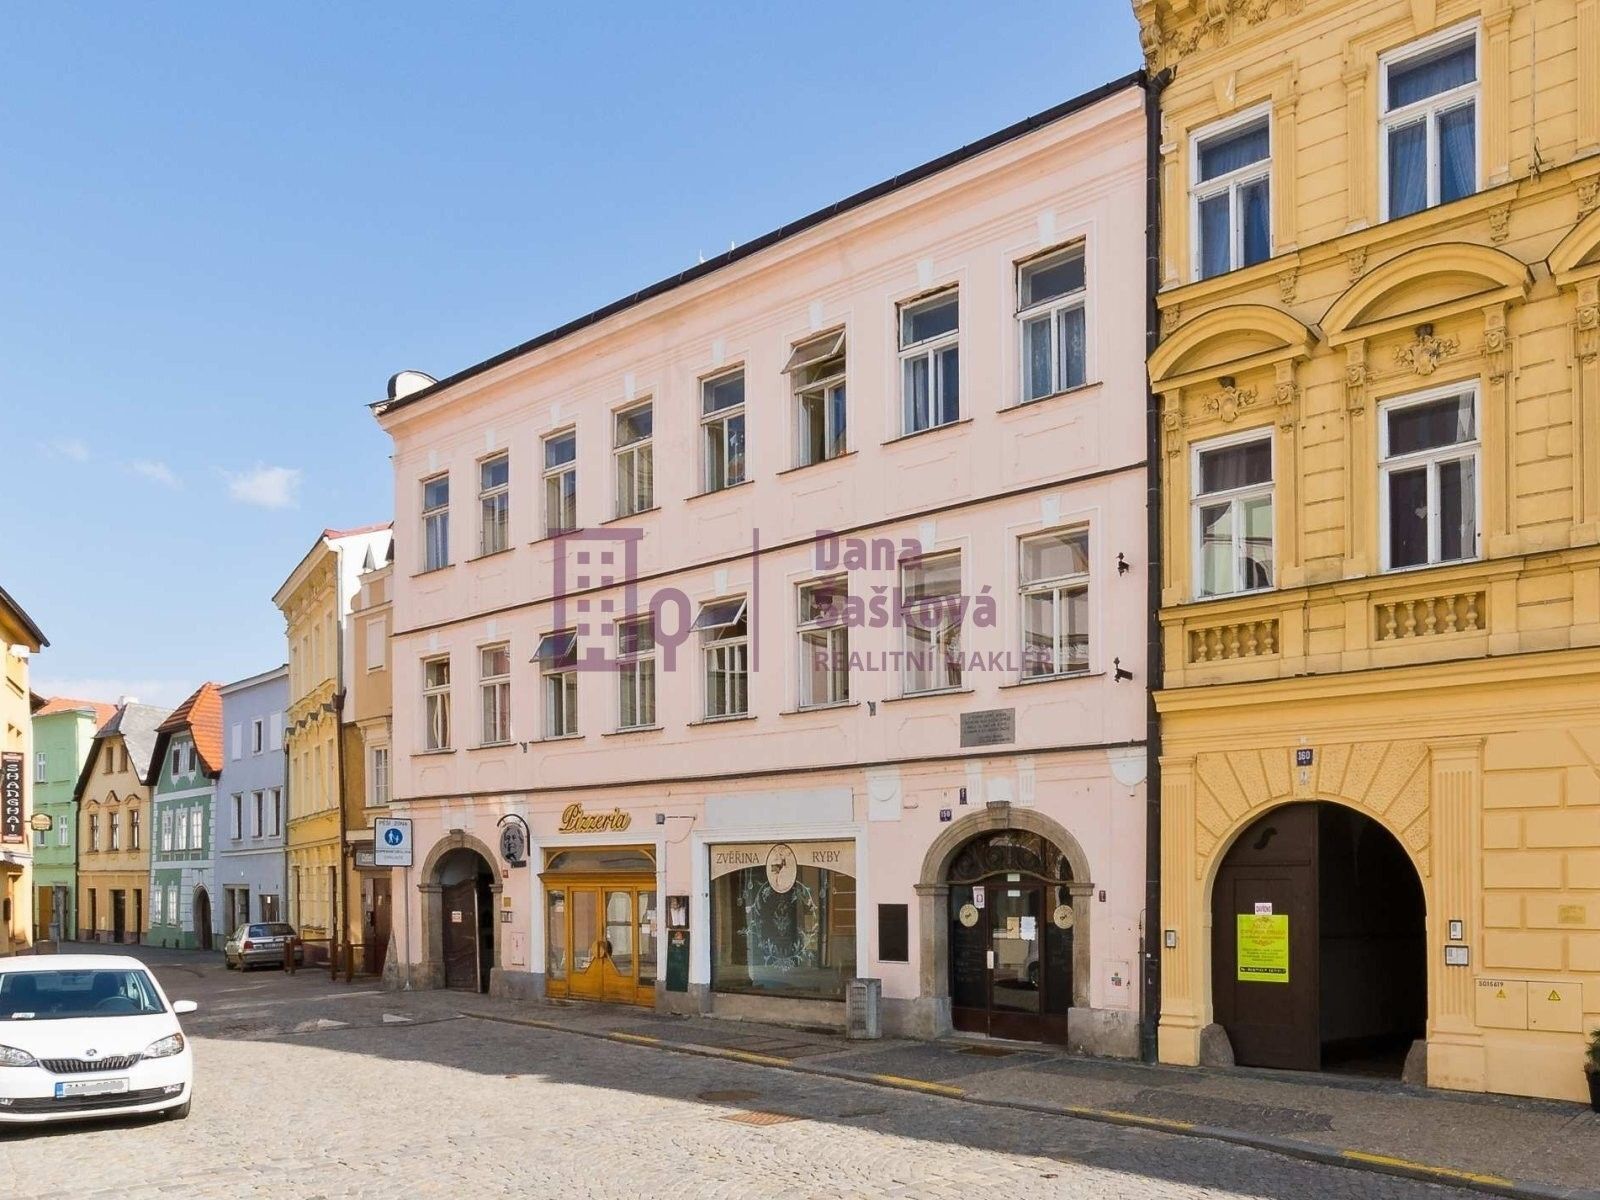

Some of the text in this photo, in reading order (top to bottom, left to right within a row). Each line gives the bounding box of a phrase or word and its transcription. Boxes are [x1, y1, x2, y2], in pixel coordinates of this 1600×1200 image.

[6, 764, 20, 832] SHANGHAI
[558, 803, 632, 834] Pizzeria
[716, 850, 841, 864] ZVĚŘINA RYBY
